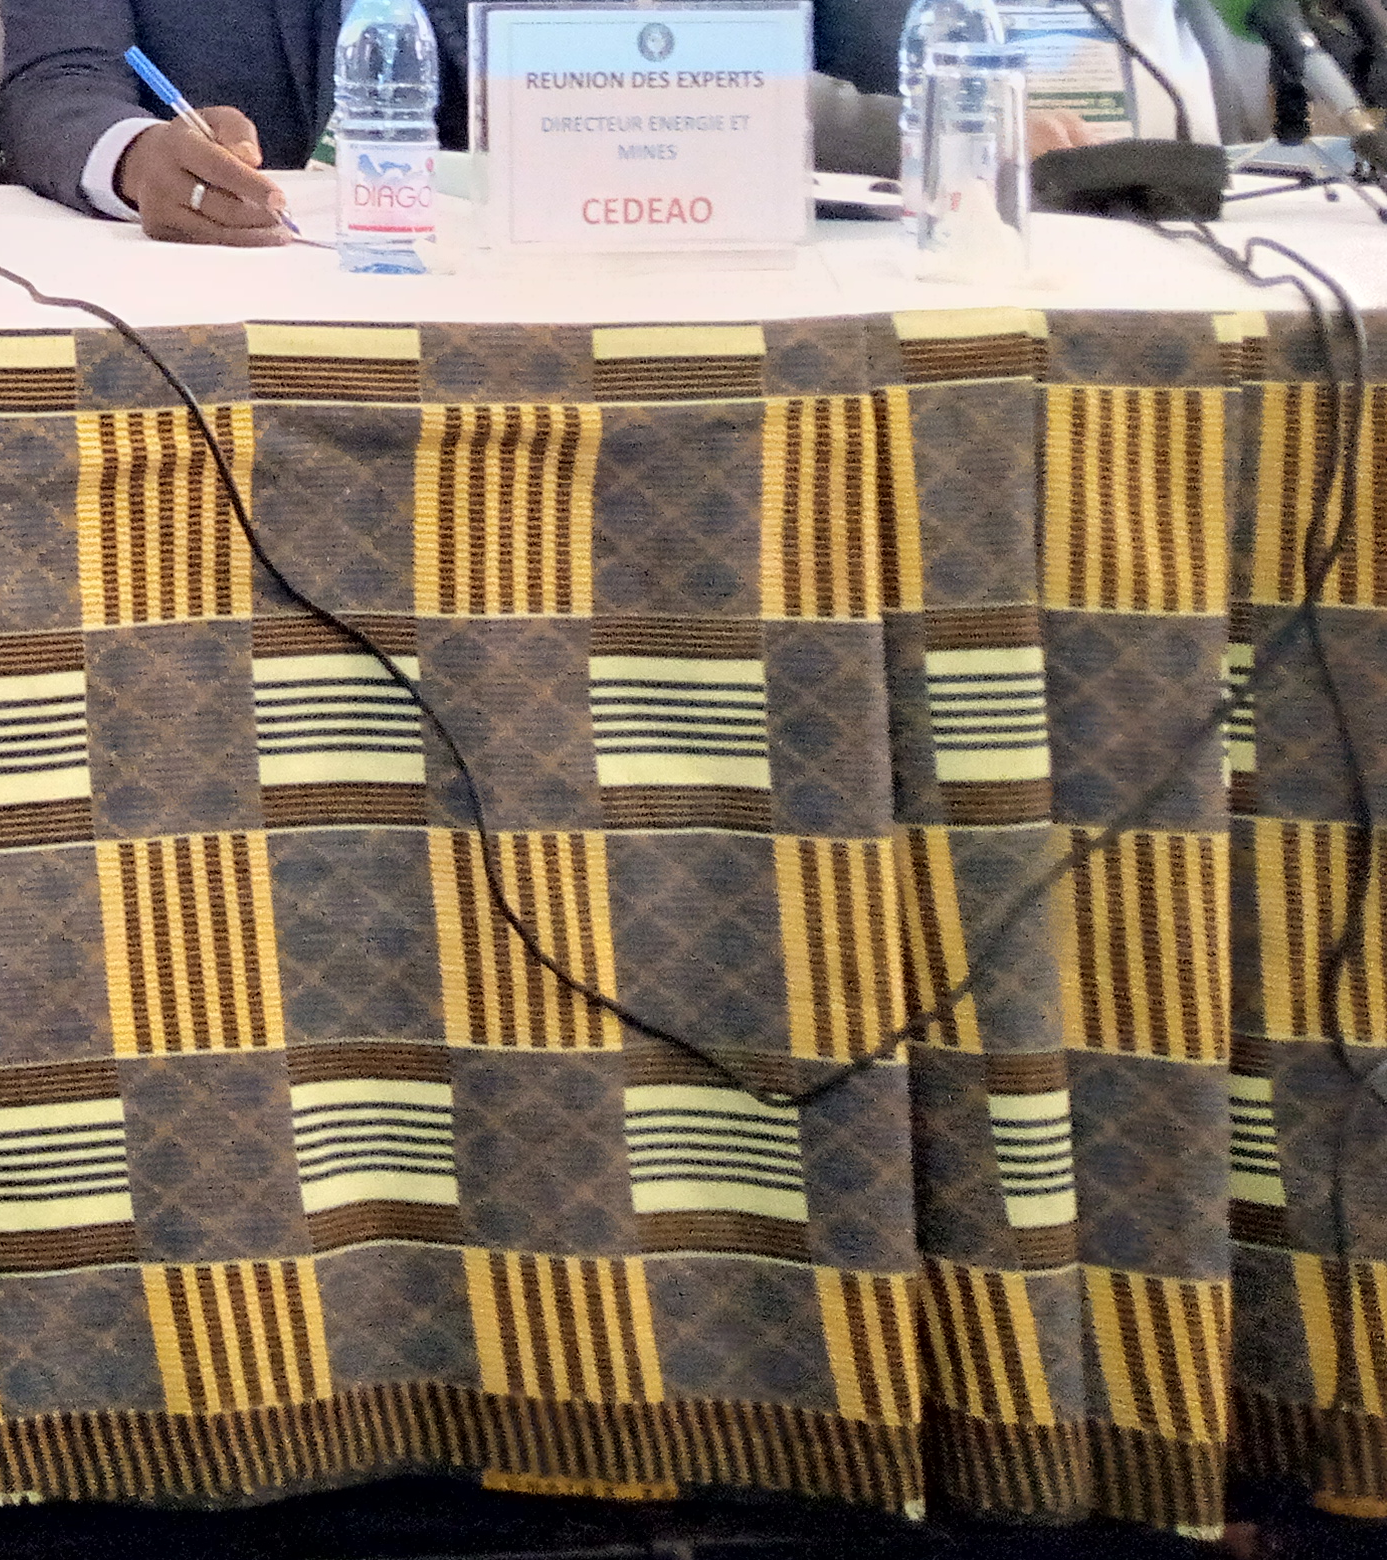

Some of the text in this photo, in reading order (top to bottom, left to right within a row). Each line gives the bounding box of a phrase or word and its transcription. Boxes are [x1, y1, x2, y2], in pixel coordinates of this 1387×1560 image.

[526, 69, 765, 90] REUNION DES EXPERTS
[541, 114, 751, 133] DIRECTEUR ENERGIE ET
[618, 144, 678, 160] MINES
[582, 196, 713, 225] CEDEAO
